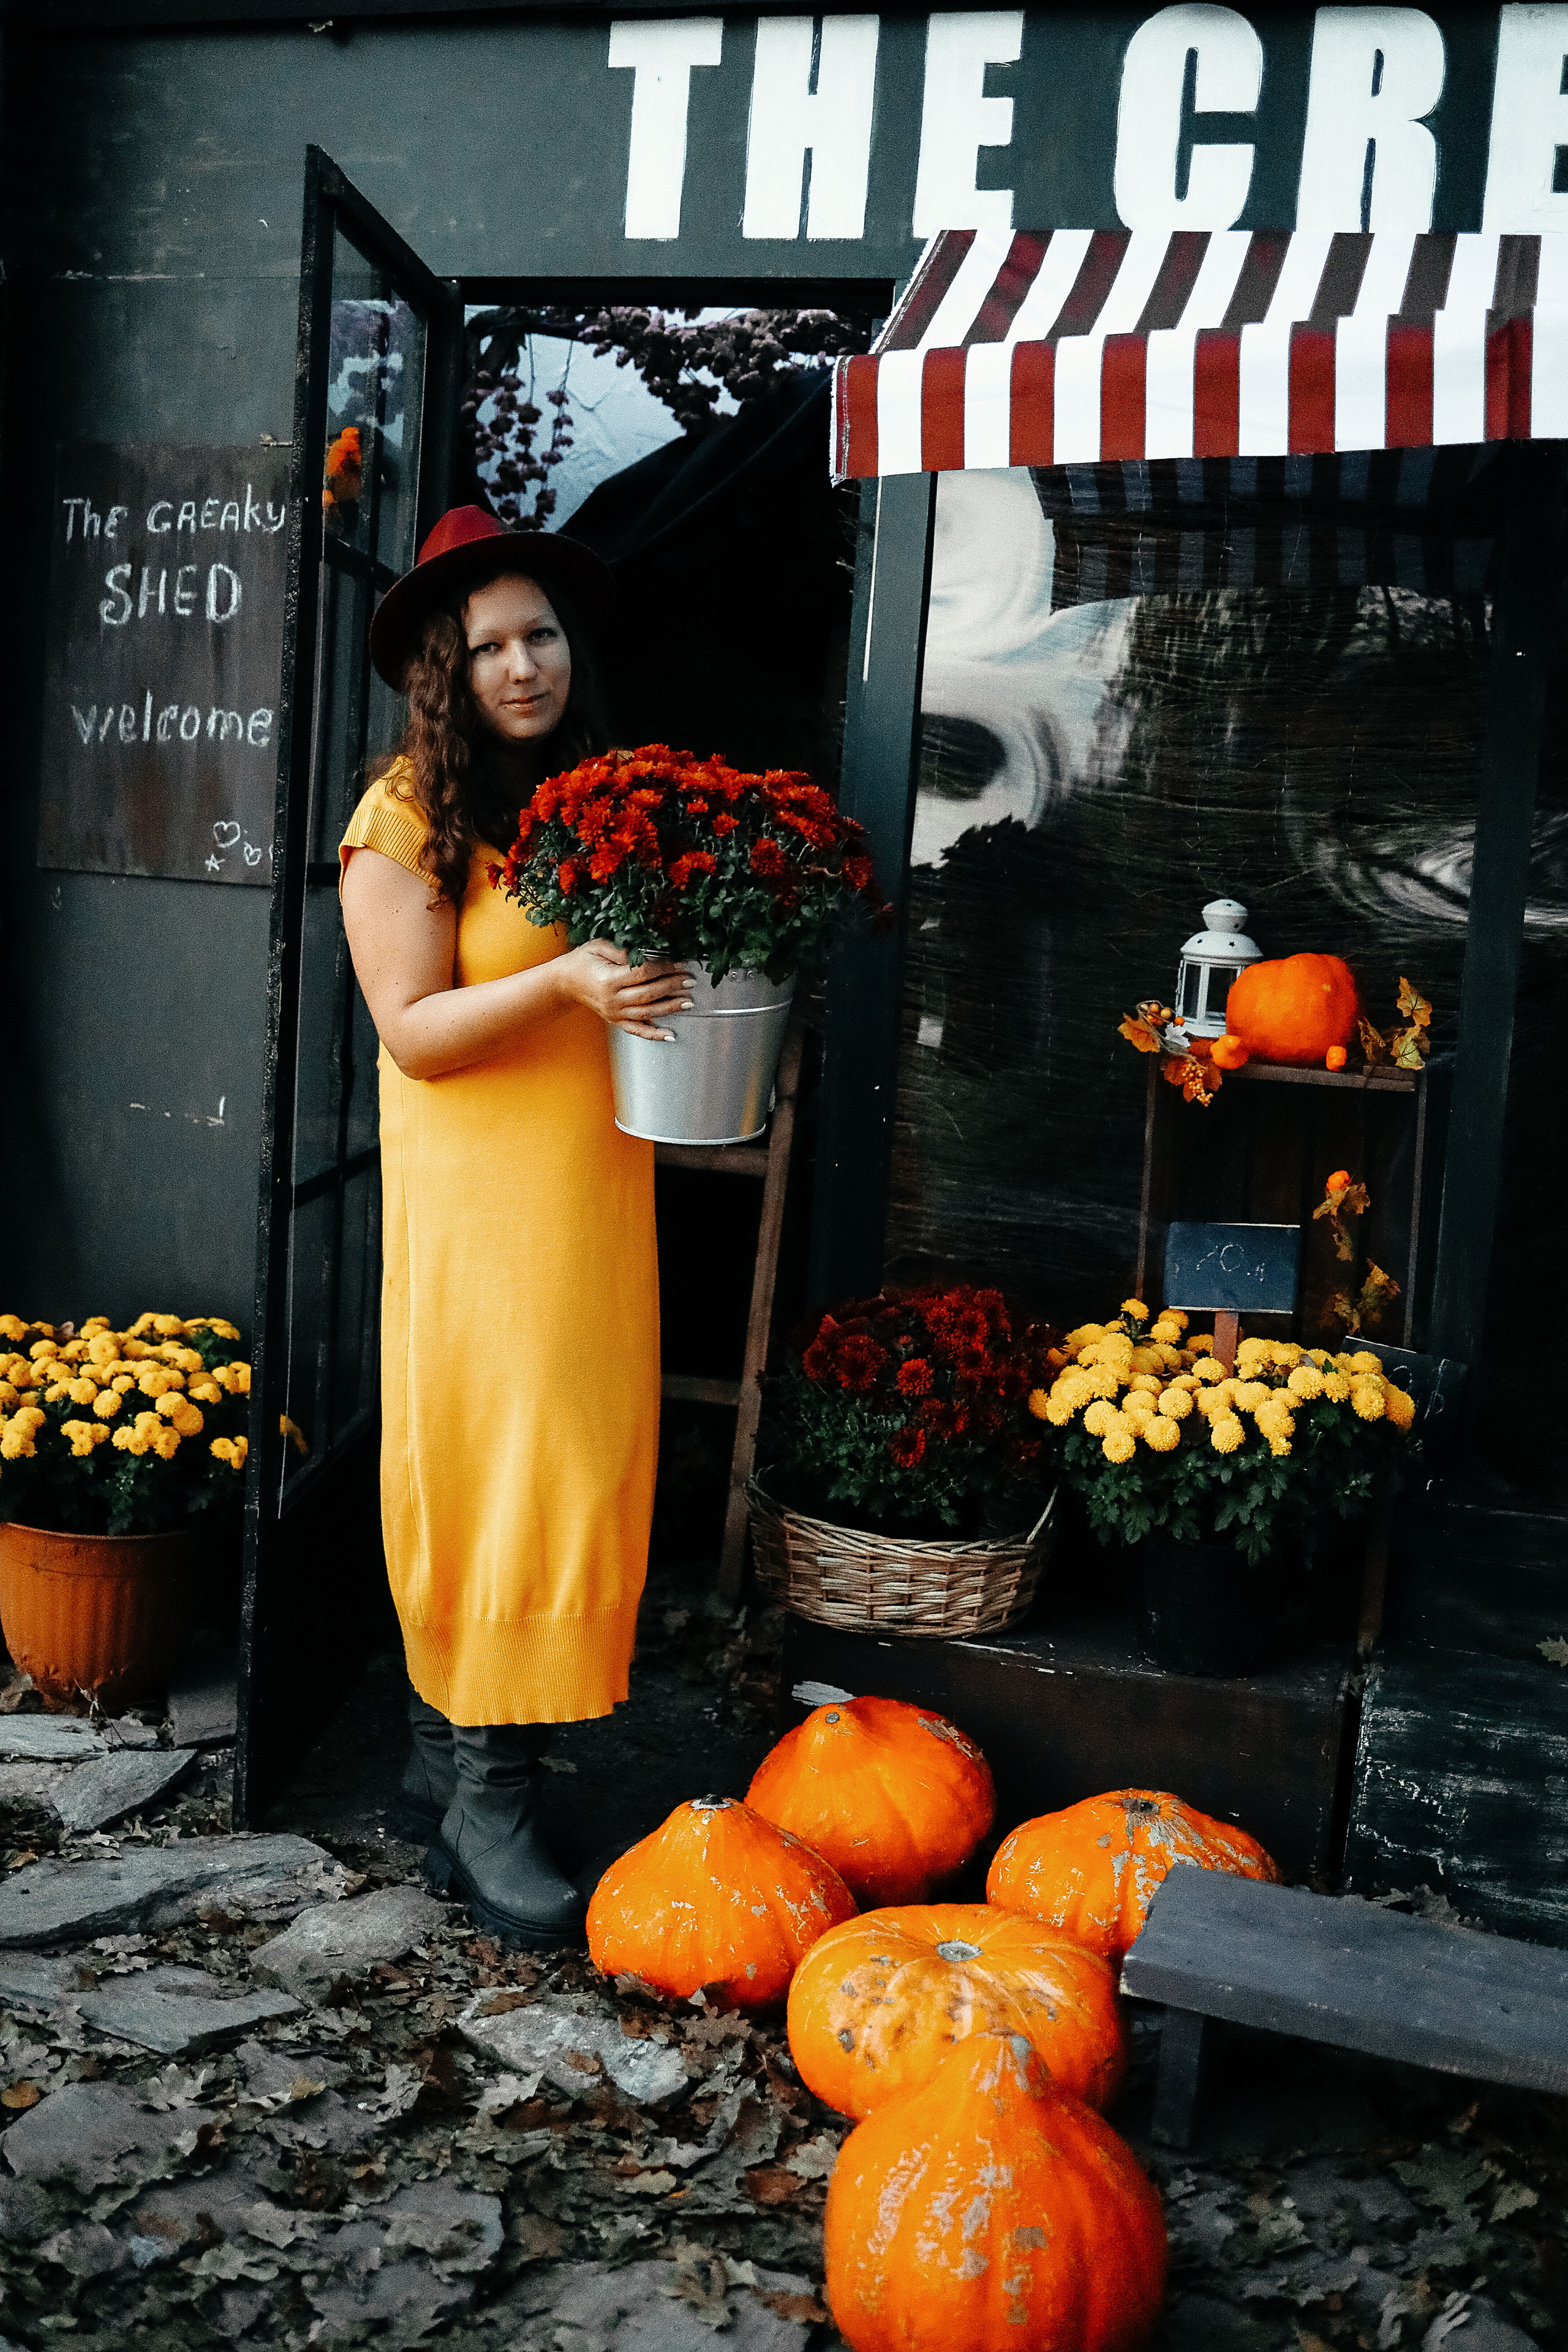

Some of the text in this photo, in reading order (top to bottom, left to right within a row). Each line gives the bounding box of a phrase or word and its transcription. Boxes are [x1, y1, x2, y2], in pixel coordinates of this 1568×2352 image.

[608, 2, 1568, 240] THE CRE
[99, 563, 243, 625] SHED
[70, 689, 275, 747] welcome
